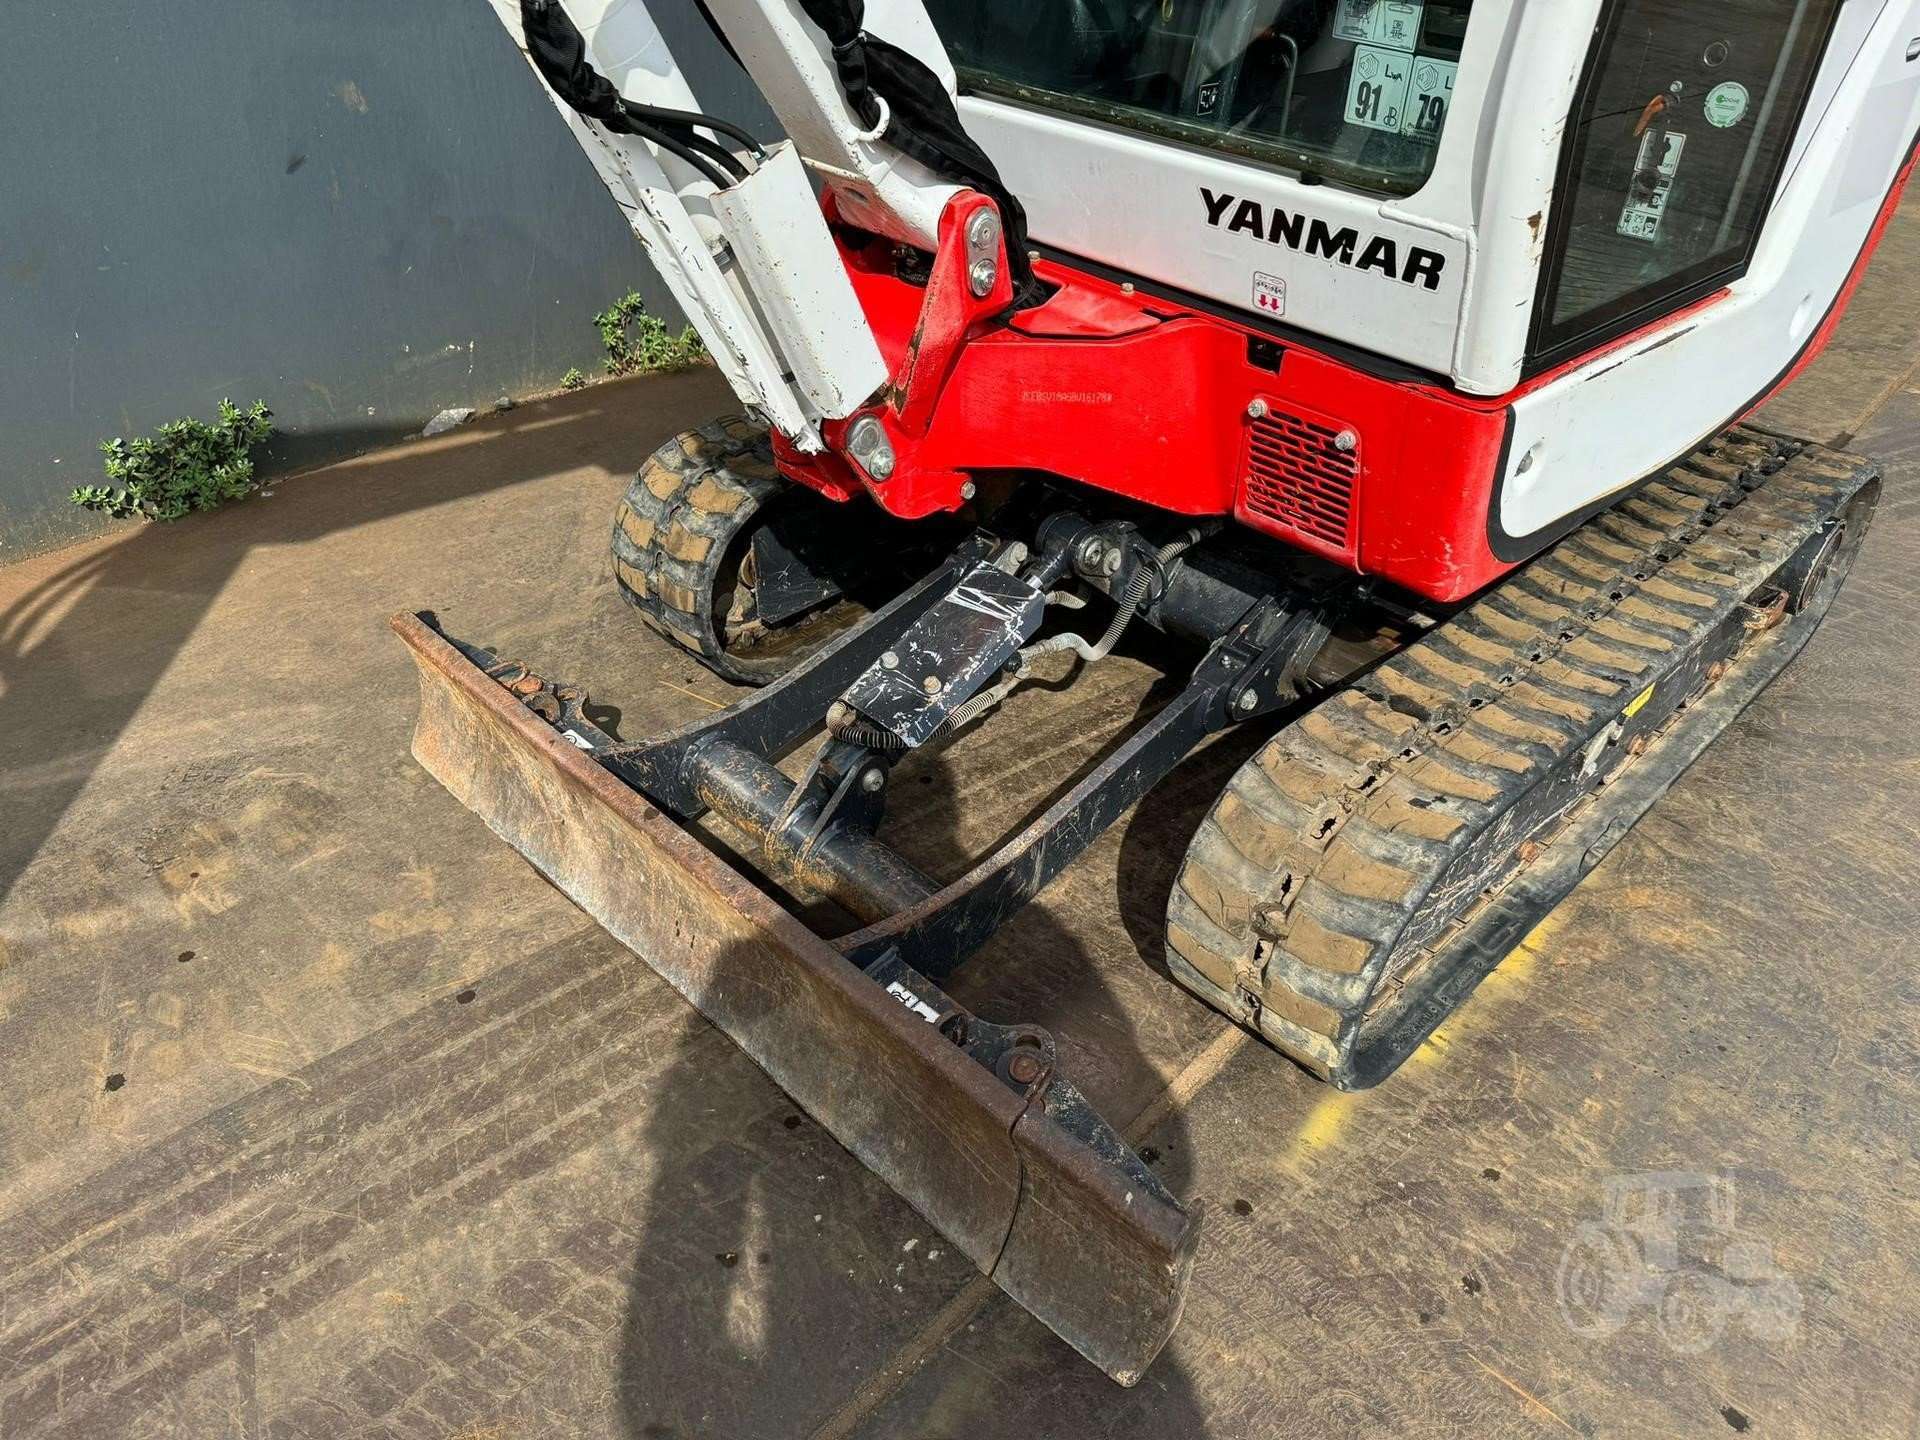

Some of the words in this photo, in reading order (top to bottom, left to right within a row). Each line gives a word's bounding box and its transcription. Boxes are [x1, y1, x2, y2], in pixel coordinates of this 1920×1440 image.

[1355, 81, 1382, 121] 91
[1415, 94, 1445, 133] 79
[1199, 187, 1446, 291] YANMAR
